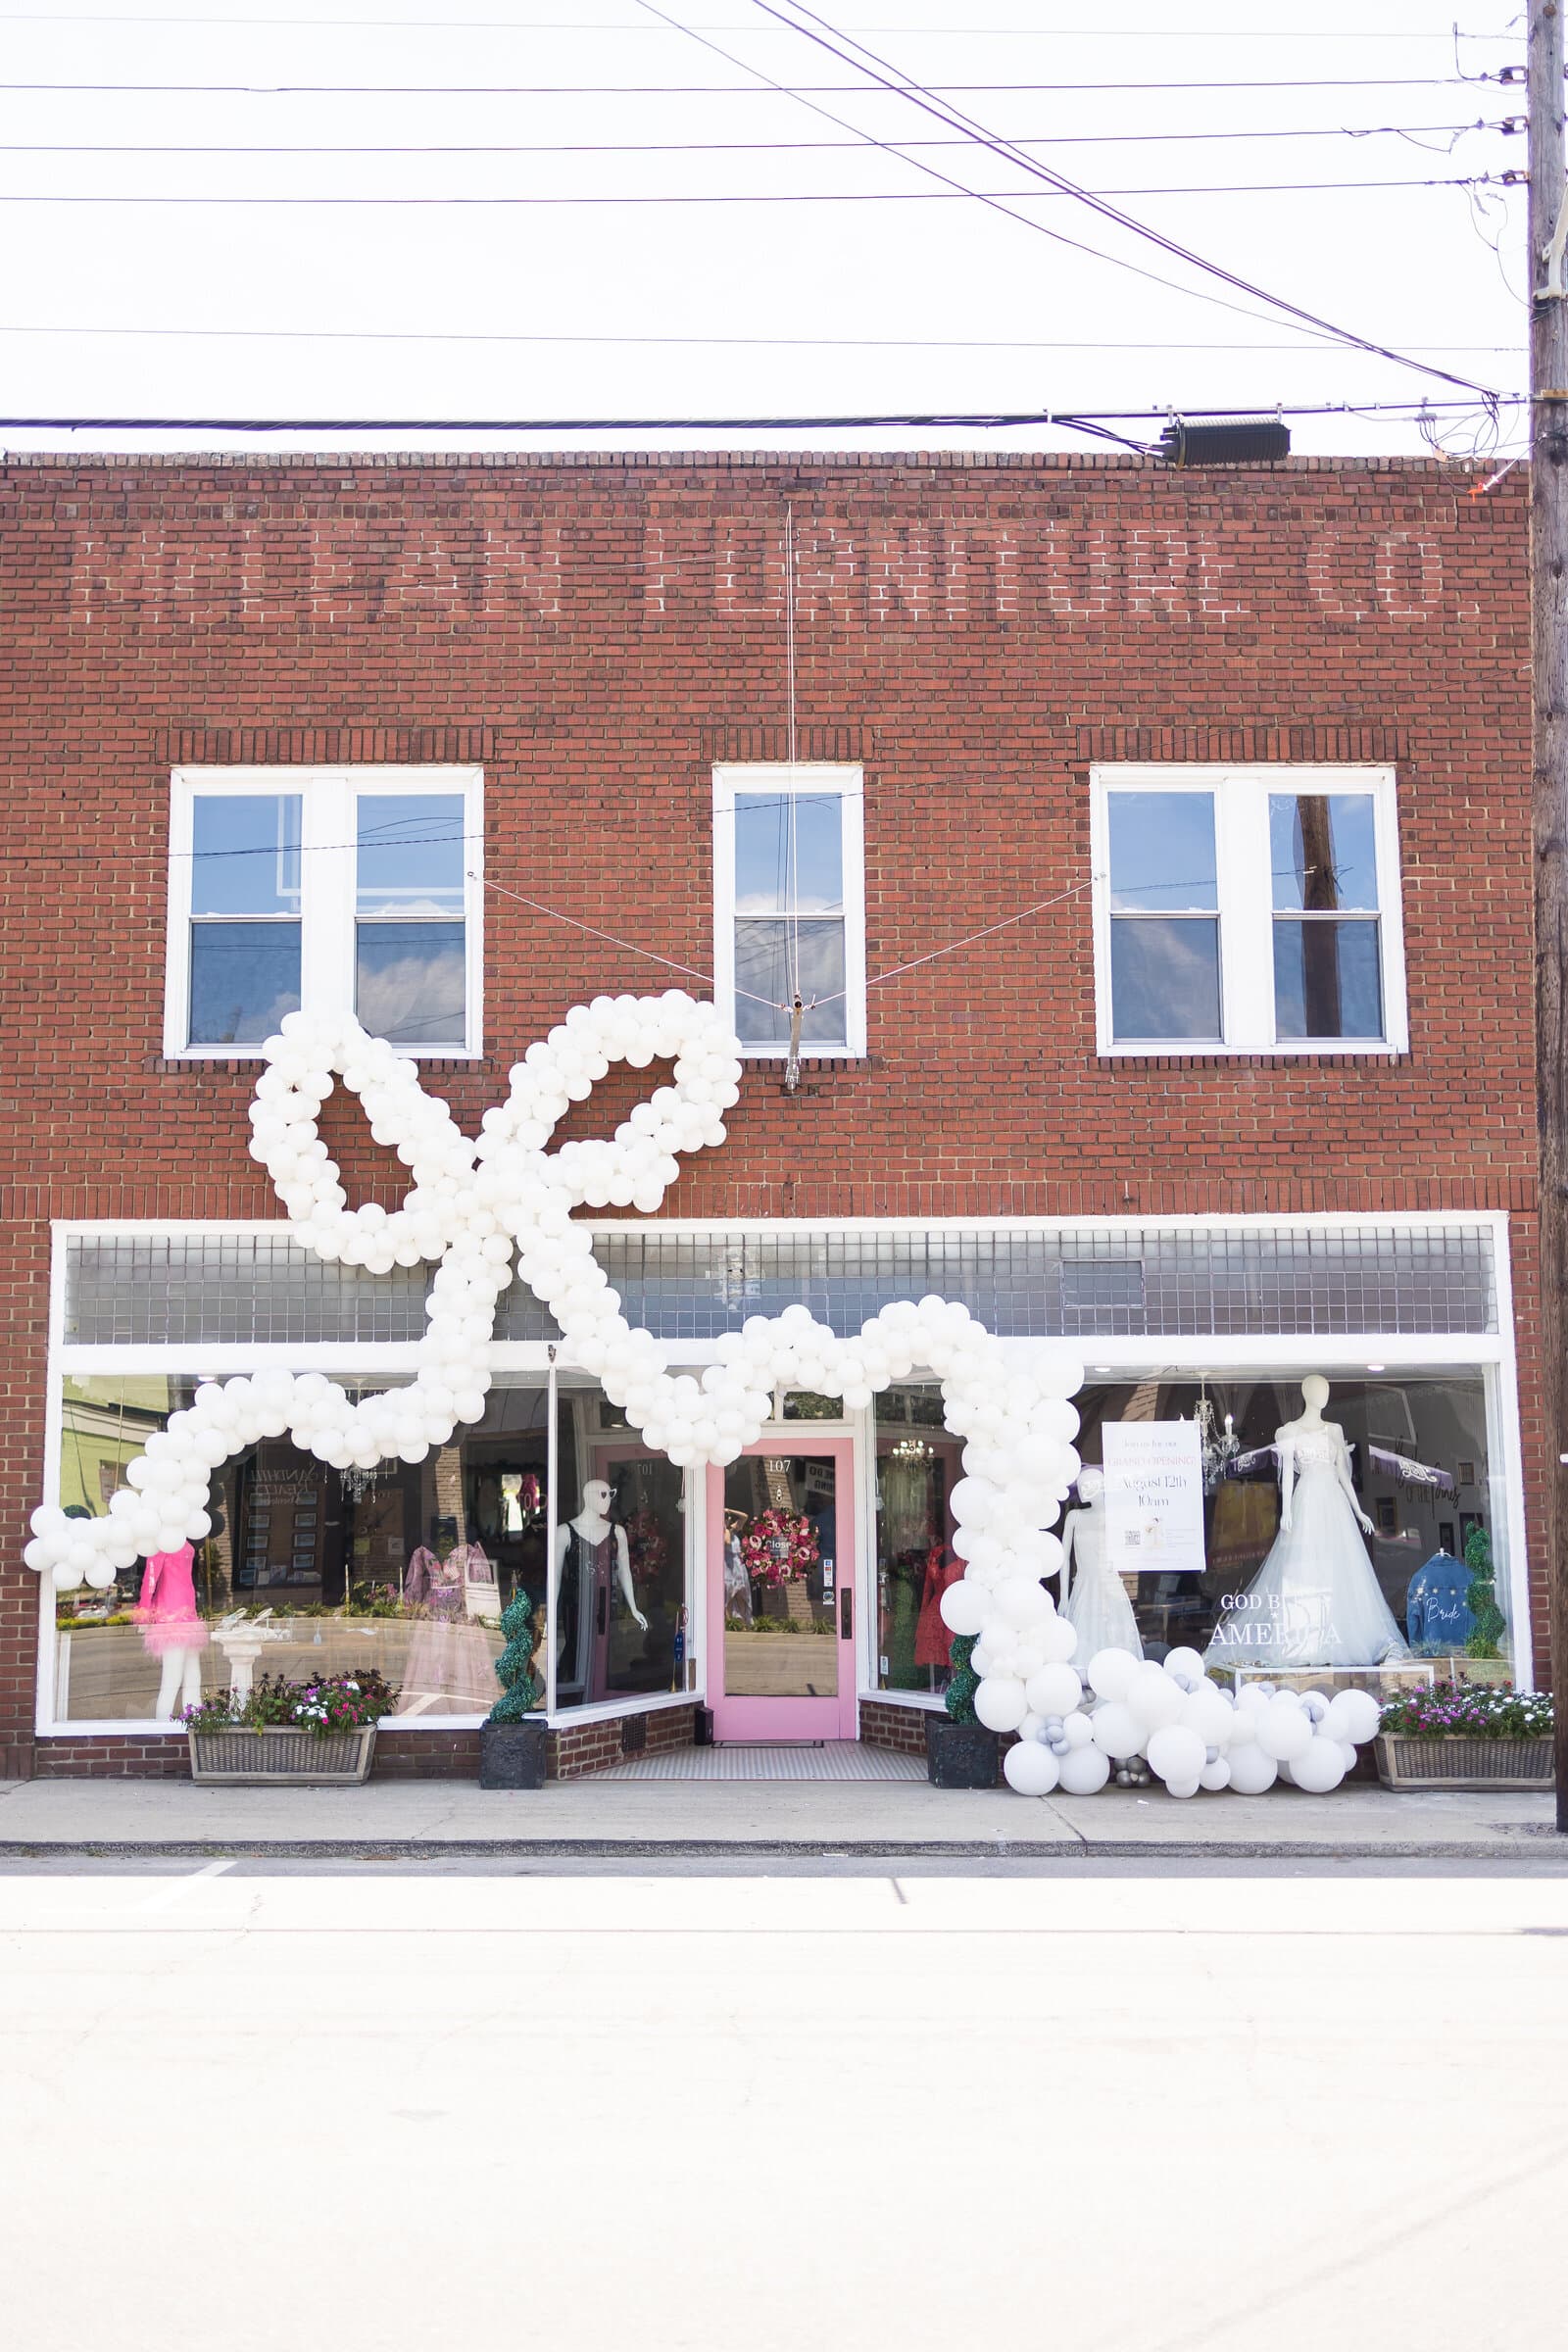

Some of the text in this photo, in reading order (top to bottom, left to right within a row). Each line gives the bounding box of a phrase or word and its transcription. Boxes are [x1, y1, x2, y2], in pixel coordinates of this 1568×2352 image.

[769, 1460, 791, 1473] 107
[1121, 1474, 1188, 1492] August 12th
[1138, 1494, 1169, 1506] 10am
[1220, 1593, 1262, 1610] GOD
[1426, 1596, 1460, 1625] Bride
